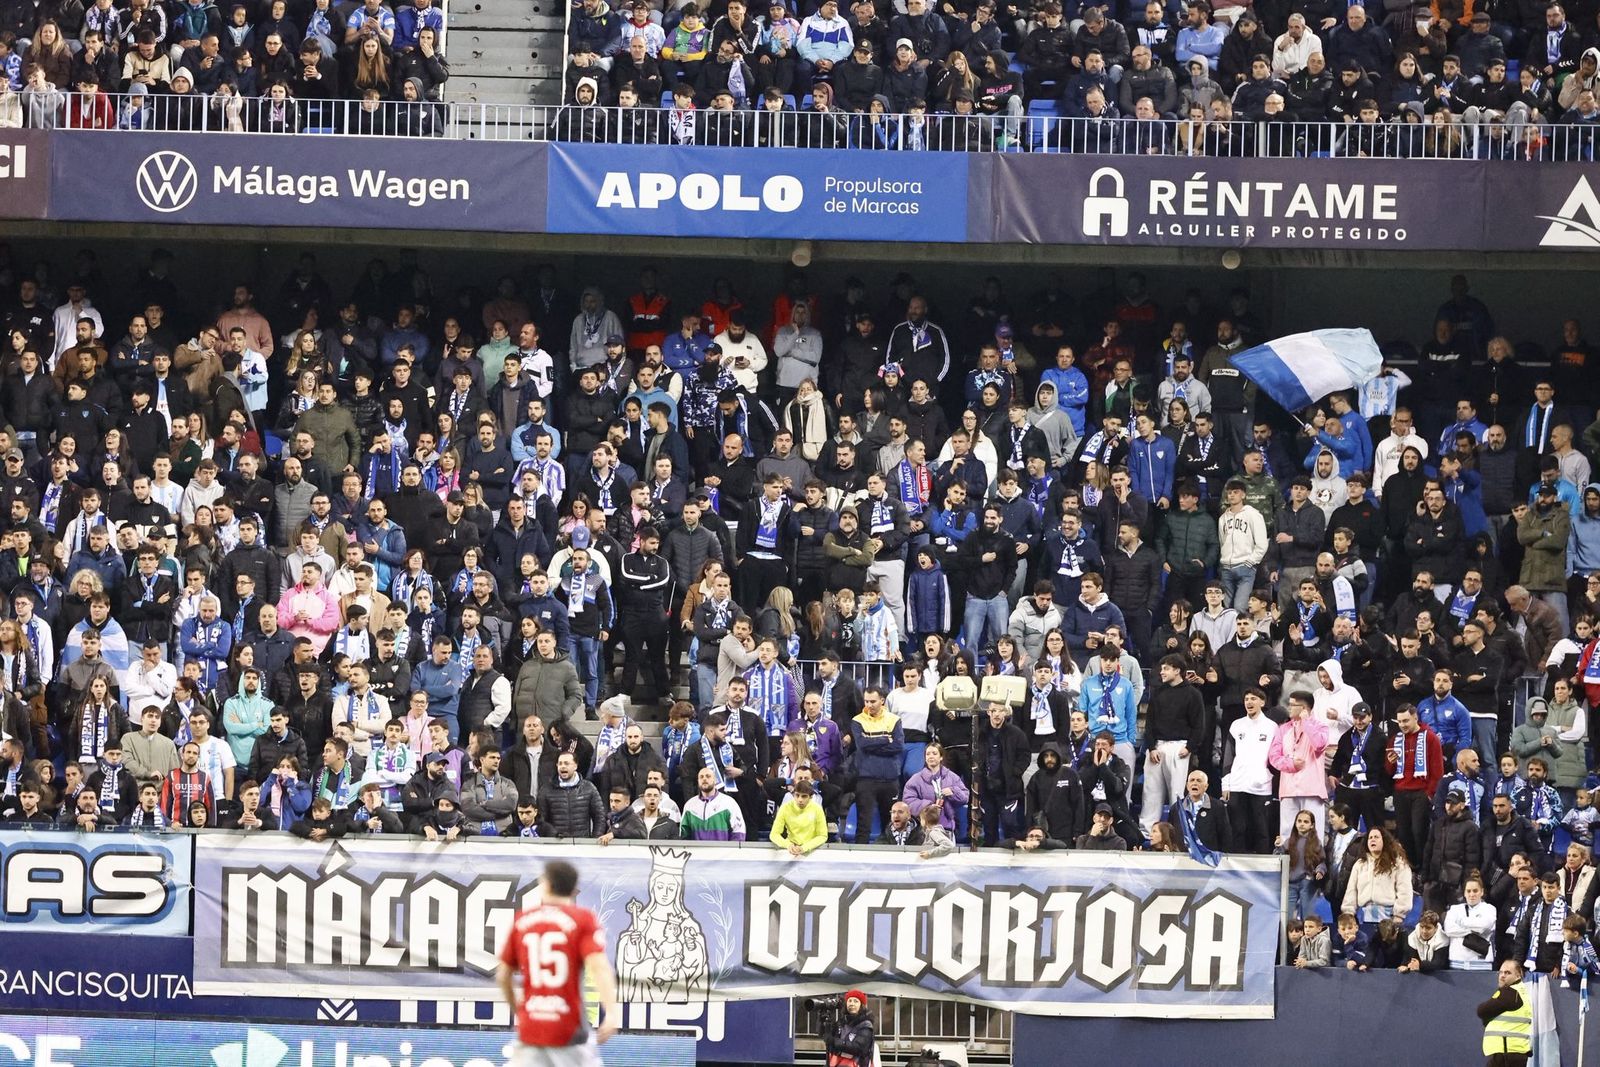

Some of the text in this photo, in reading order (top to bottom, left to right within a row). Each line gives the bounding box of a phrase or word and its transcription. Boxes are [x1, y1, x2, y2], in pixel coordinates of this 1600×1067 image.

[213, 165, 470, 207] Málaga Wagen
[596, 172, 804, 213] APOLO
[824, 197, 919, 215] de Marcas
[825, 176, 923, 201] Propulsora
[1149, 171, 1398, 221] RÉNTAME
[1138, 222, 1408, 242] ALQUILER PROTEGIDO
[174, 783, 203, 791] GUESS
[0, 849, 168, 921] AS
[221, 840, 542, 978] MÁLAG
[521, 931, 569, 988] 15
[0, 969, 193, 1002] RANCISQUITA
